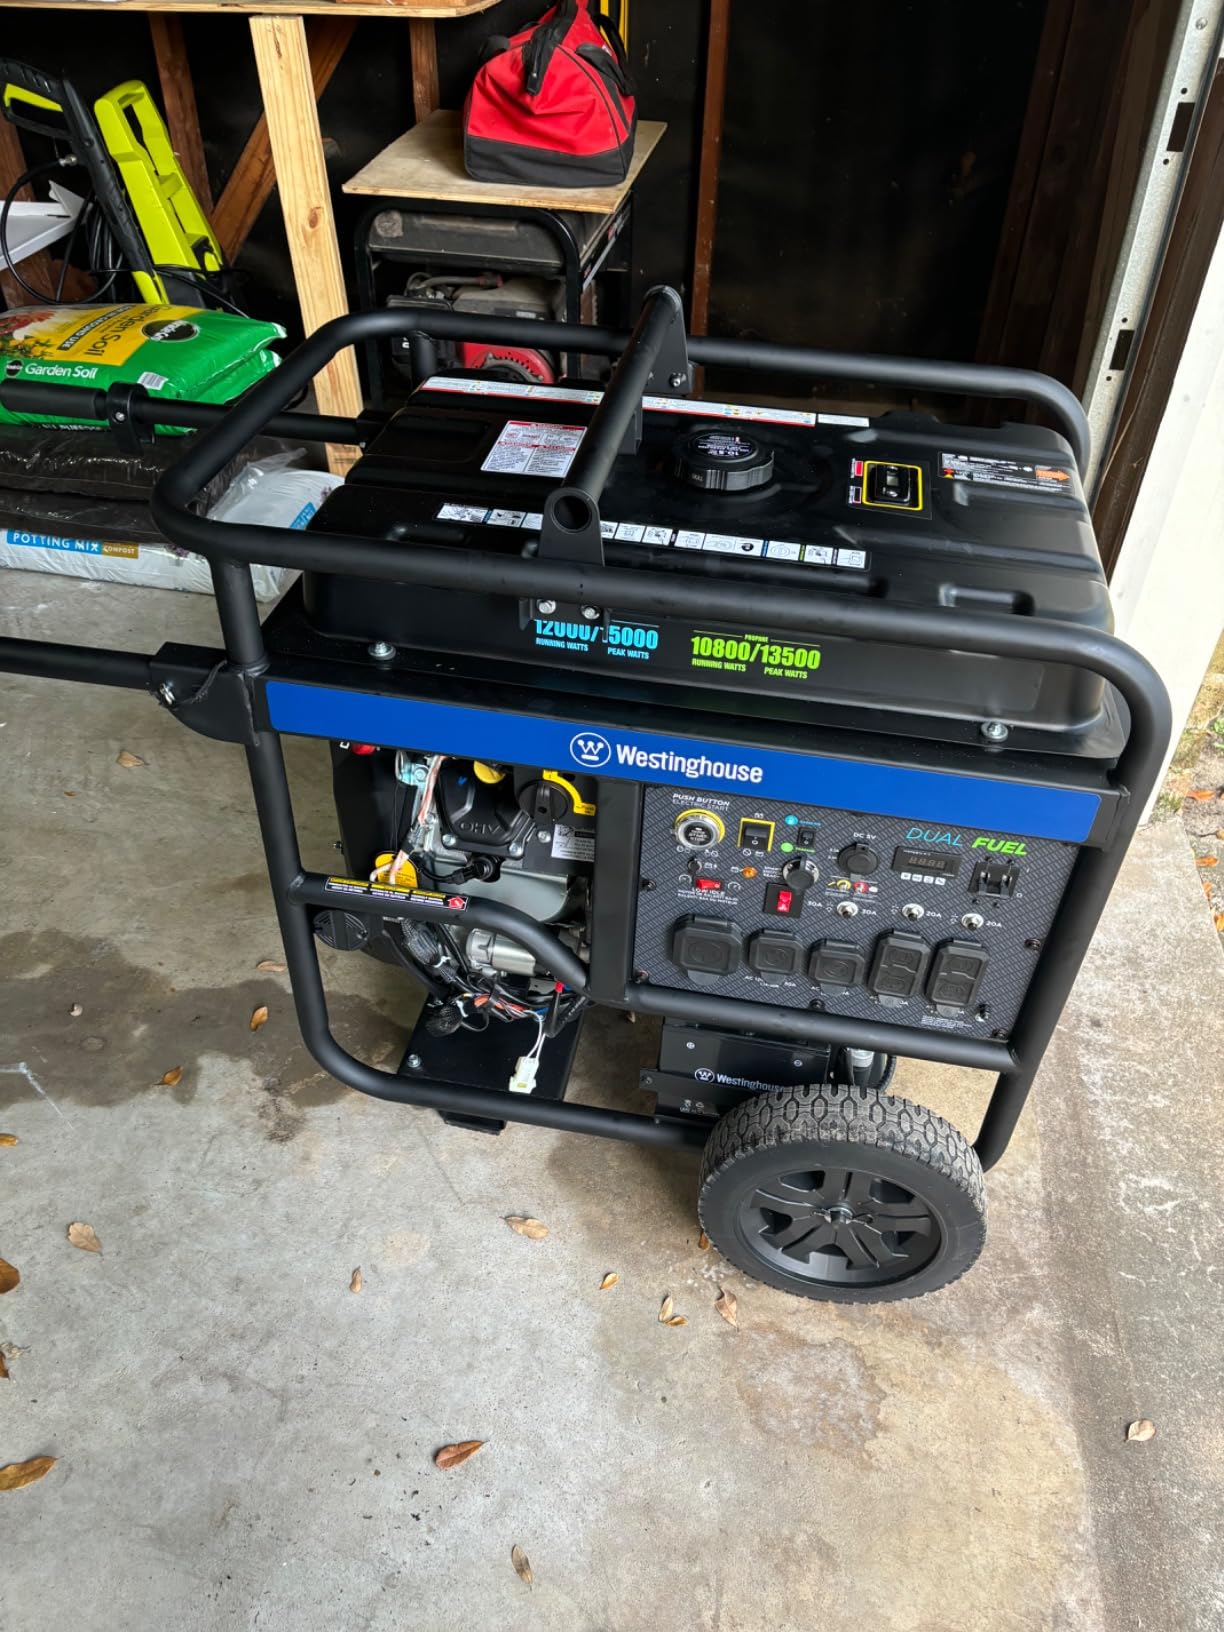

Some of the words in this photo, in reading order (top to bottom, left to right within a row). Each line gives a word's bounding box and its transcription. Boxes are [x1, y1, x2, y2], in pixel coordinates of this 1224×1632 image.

[84, 333, 121, 357] Soil
[25, 363, 71, 377] Garden
[72, 365, 99, 379] Soil
[13, 532, 70, 549] POTTING
[74, 540, 99, 552] MIX
[536, 638, 565, 649] RUNNING
[567, 641, 589, 652] WATTS
[608, 647, 625, 656] PEAK
[627, 649, 650, 659] WATTS
[691, 636, 821, 670] 10800/13500
[692, 658, 722, 669] RUNNING
[724, 661, 746, 672] WATTS
[764, 667, 784, 676] PEAK
[785, 669, 808, 679] WATTS
[616, 744, 764, 783] Westinghouse
[673, 793, 695, 801] PUSH
[696, 796, 730, 806] BUTTON
[906, 828, 962, 846] DUAL
[971, 837, 1027, 855] FUEL
